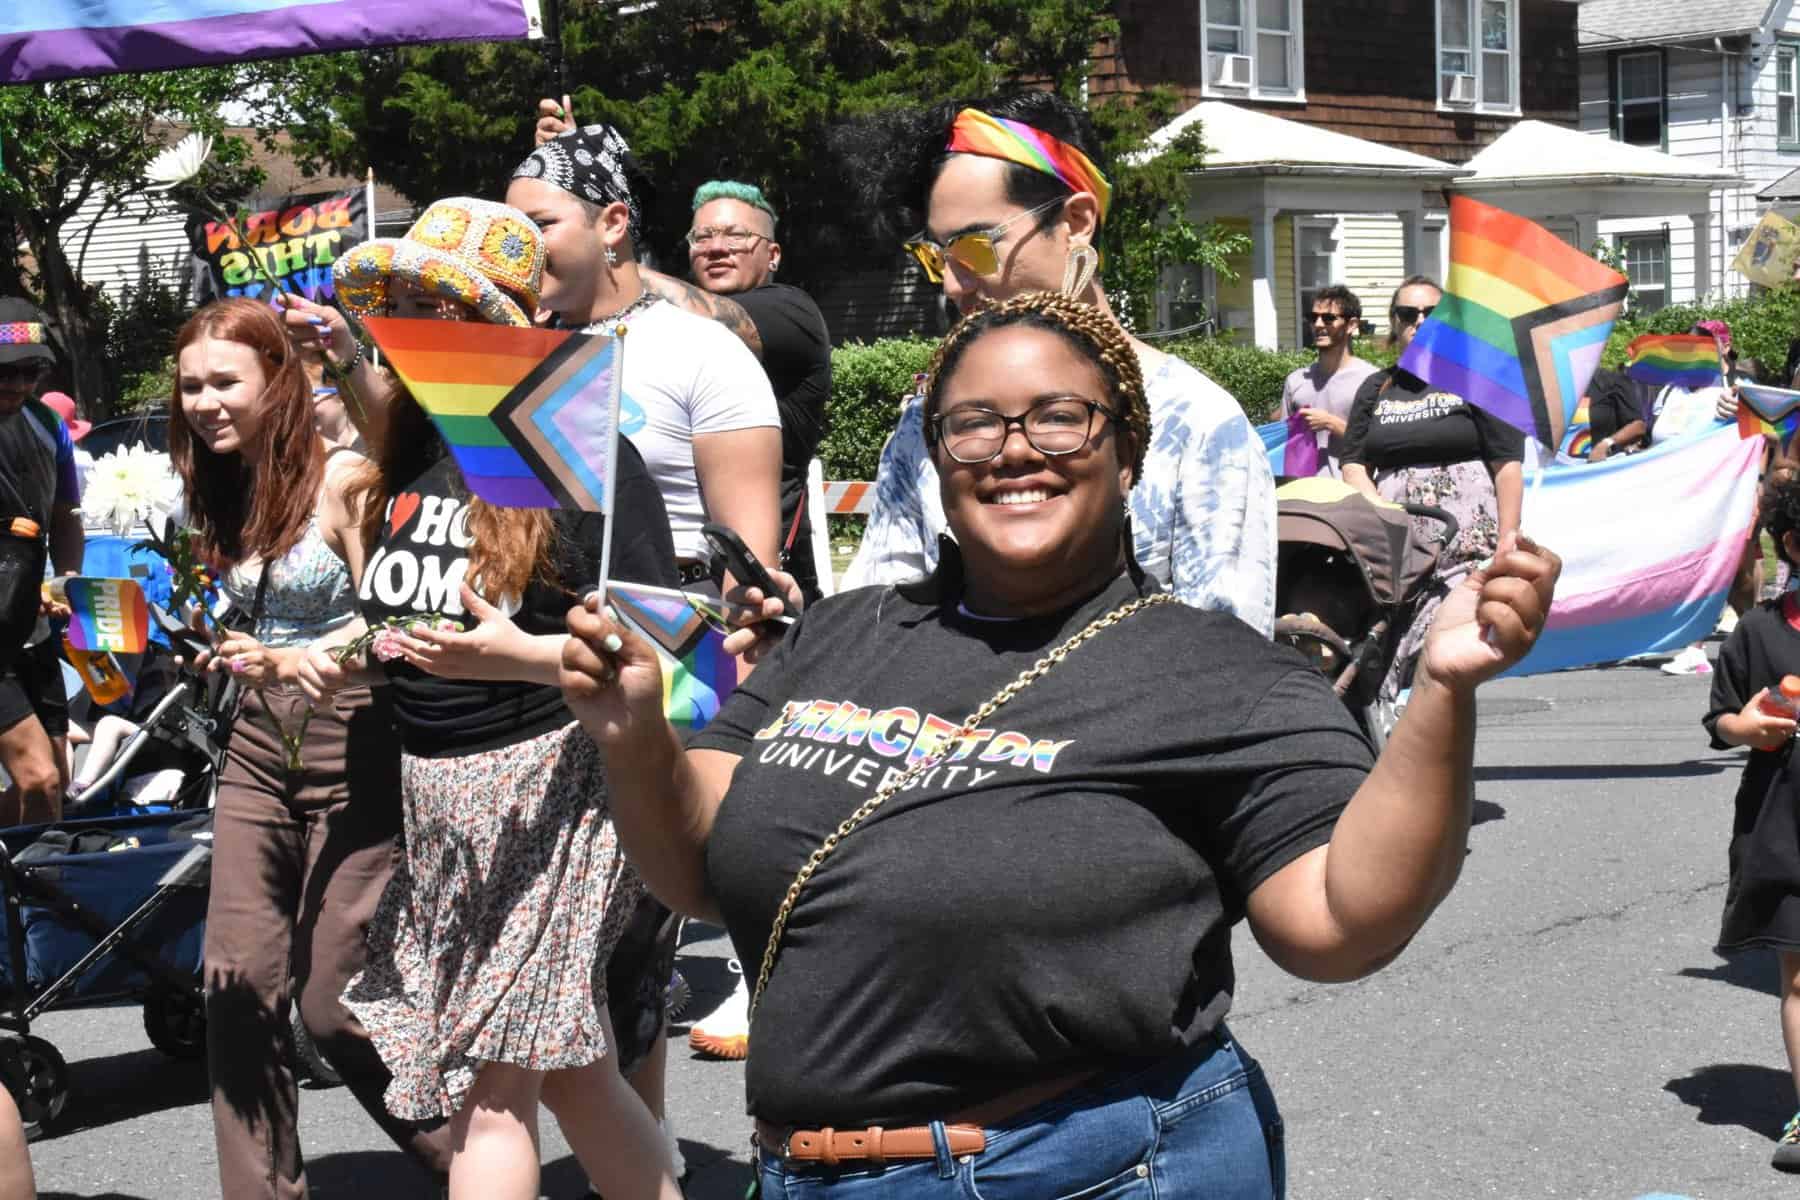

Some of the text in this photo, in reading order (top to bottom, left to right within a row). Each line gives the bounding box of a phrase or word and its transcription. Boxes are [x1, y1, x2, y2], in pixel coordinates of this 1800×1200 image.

[1379, 407, 1450, 425] UNIVERSITY
[410, 495, 477, 549] HO
[359, 546, 523, 618] OM
[92, 582, 125, 648] PRIDE
[754, 699, 1076, 773] PRINCETON
[759, 742, 998, 793] UNIVERSITY
